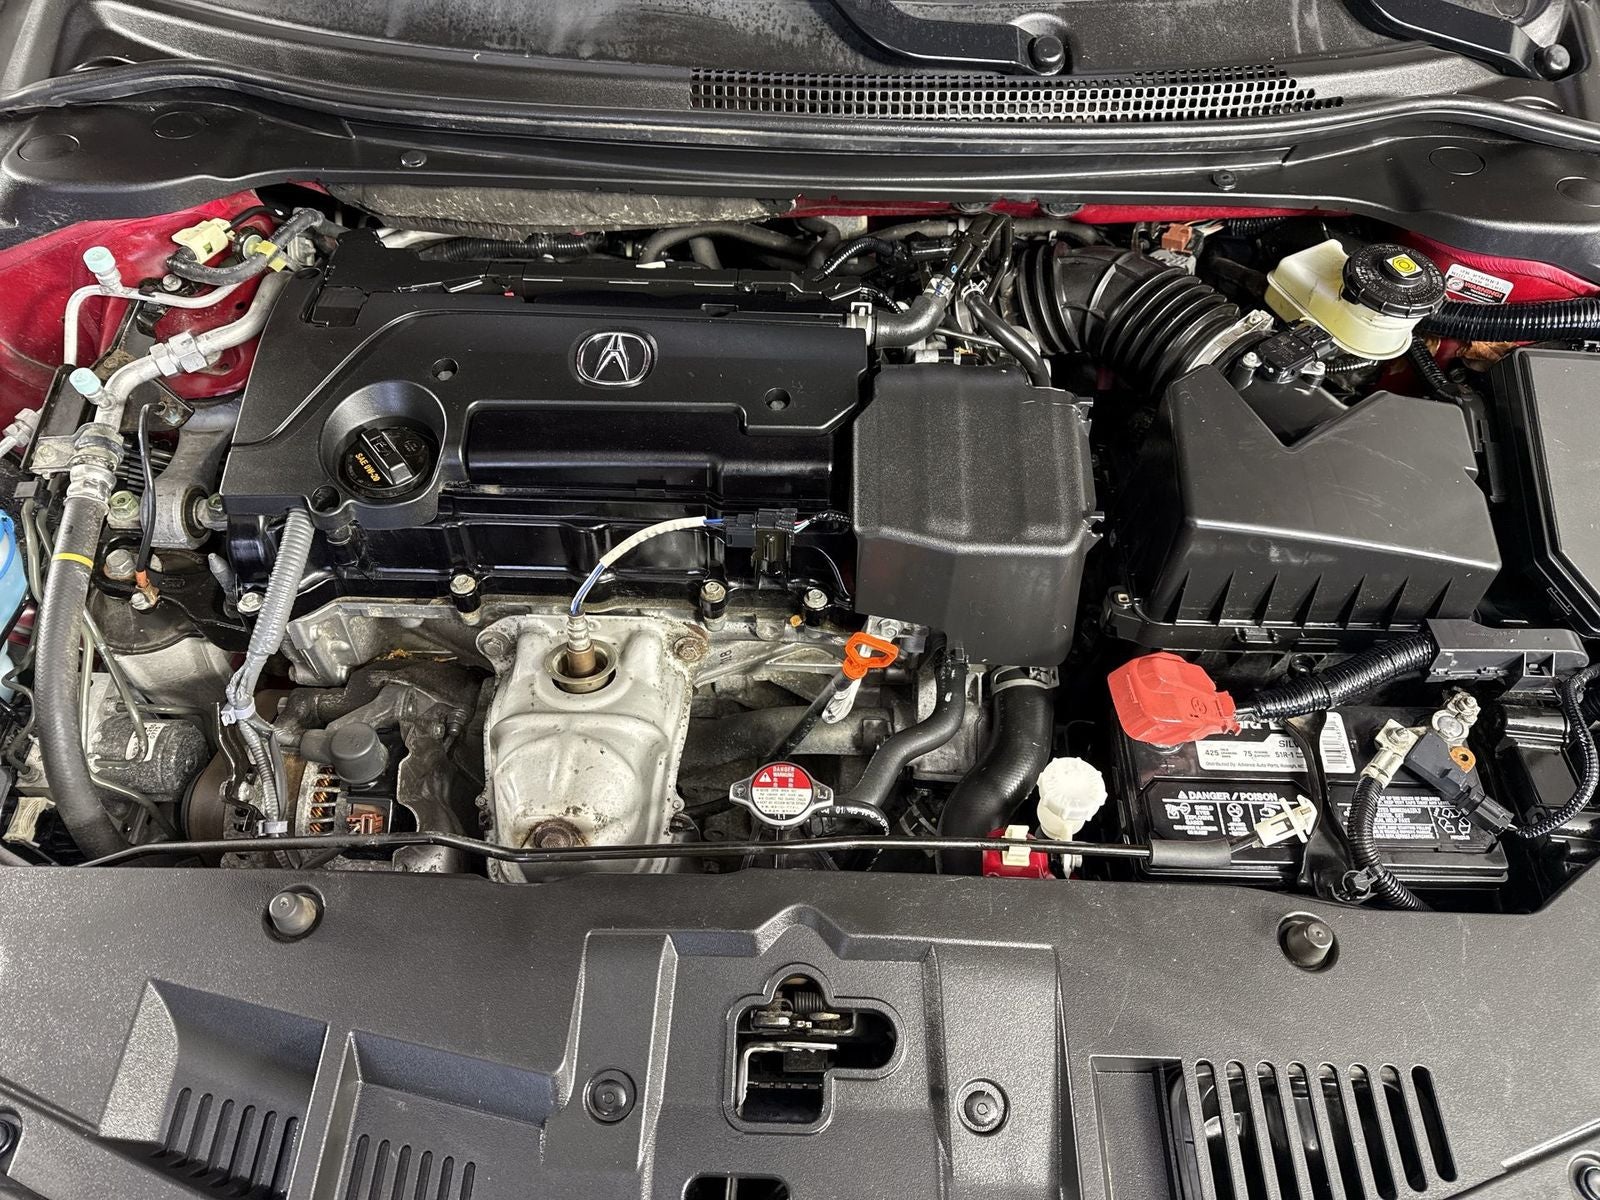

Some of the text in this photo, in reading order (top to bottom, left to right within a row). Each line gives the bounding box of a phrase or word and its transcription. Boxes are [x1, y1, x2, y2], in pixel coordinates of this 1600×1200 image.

[355, 452, 368, 469] SAE
[363, 465, 381, 482] 0W-20
[1188, 791, 1231, 800] DANGER
[1240, 792, 1278, 801] POISON
